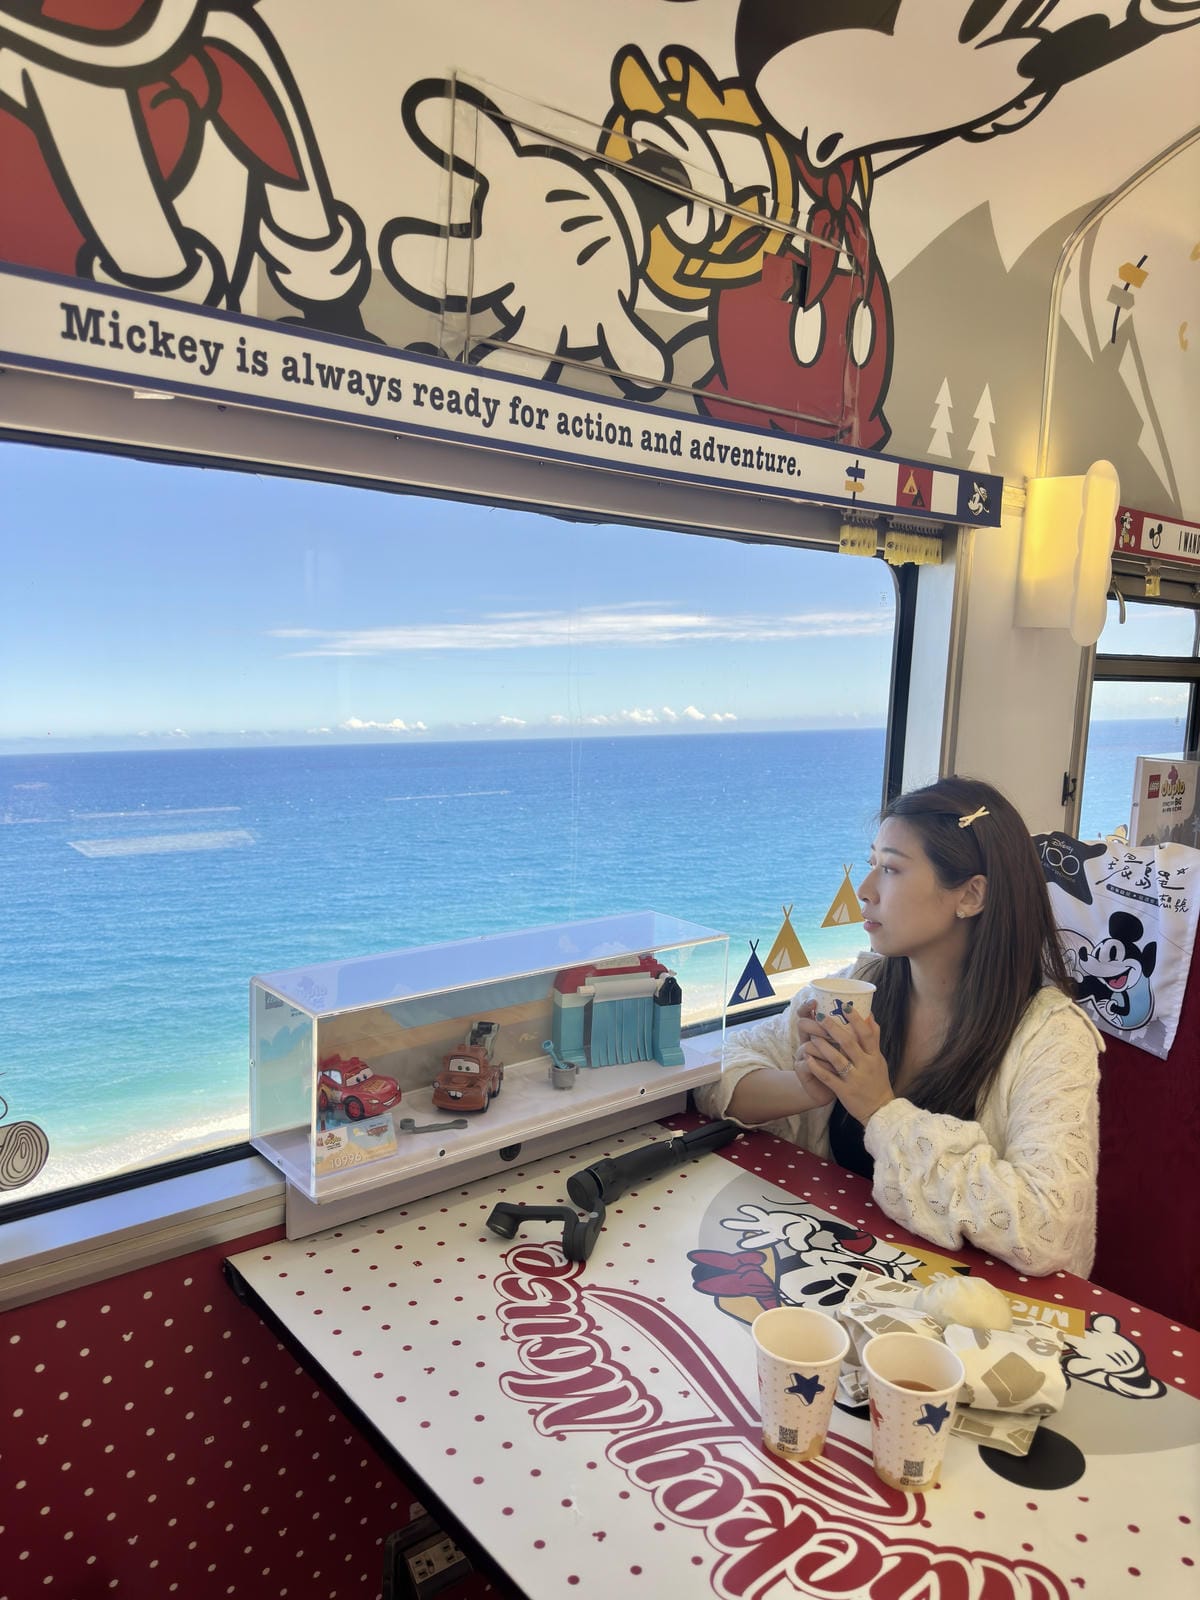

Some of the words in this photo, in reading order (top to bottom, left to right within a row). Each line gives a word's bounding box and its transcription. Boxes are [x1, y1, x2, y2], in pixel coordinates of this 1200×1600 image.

[60, 302, 224, 376] Mickey
[236, 336, 269, 377] is
[281, 352, 402, 407] always
[413, 378, 501, 428] ready
[509, 395, 549, 431] for
[556, 412, 633, 448] action
[640, 429, 683, 457] and
[689, 436, 803, 478] adventure.
[1039, 840, 1080, 875] 100
[329, 1151, 363, 1169] 10996
[1010, 1299, 1070, 1328] Mic
[496, 1242, 664, 1438] Mouse
